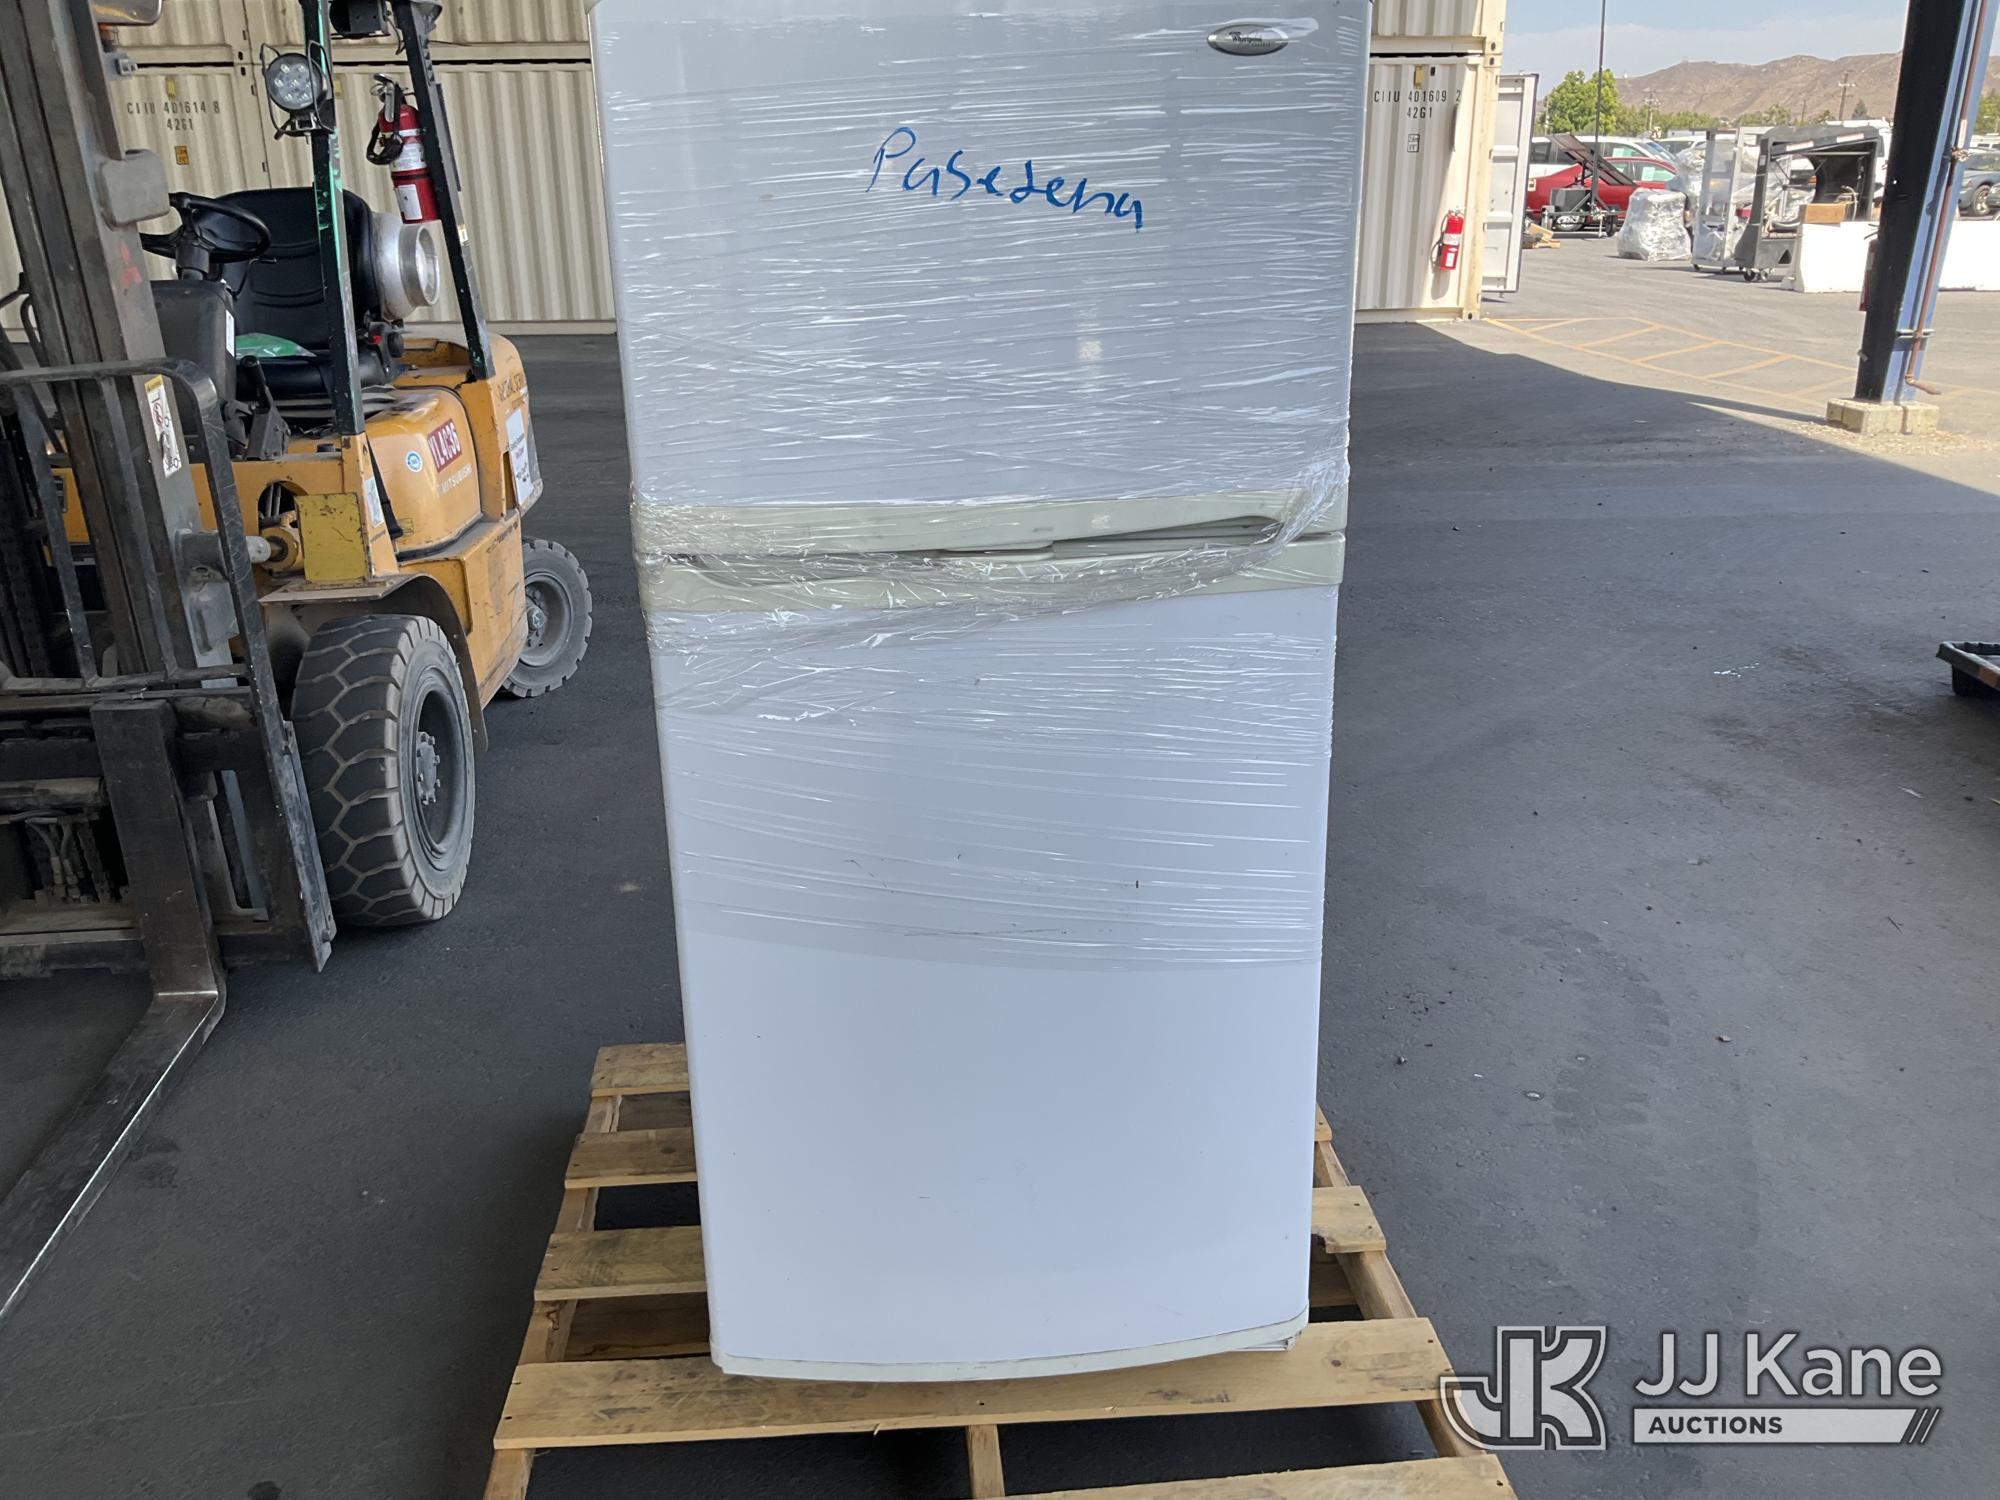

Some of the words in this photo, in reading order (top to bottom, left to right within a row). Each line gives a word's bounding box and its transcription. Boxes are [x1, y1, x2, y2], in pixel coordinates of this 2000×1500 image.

[1408, 90, 1447, 102] 401609
[1456, 89, 1462, 102] 2
[164, 101, 206, 114] 401614
[213, 101, 220, 114] 8
[1407, 106, 1432, 119] 42G1
